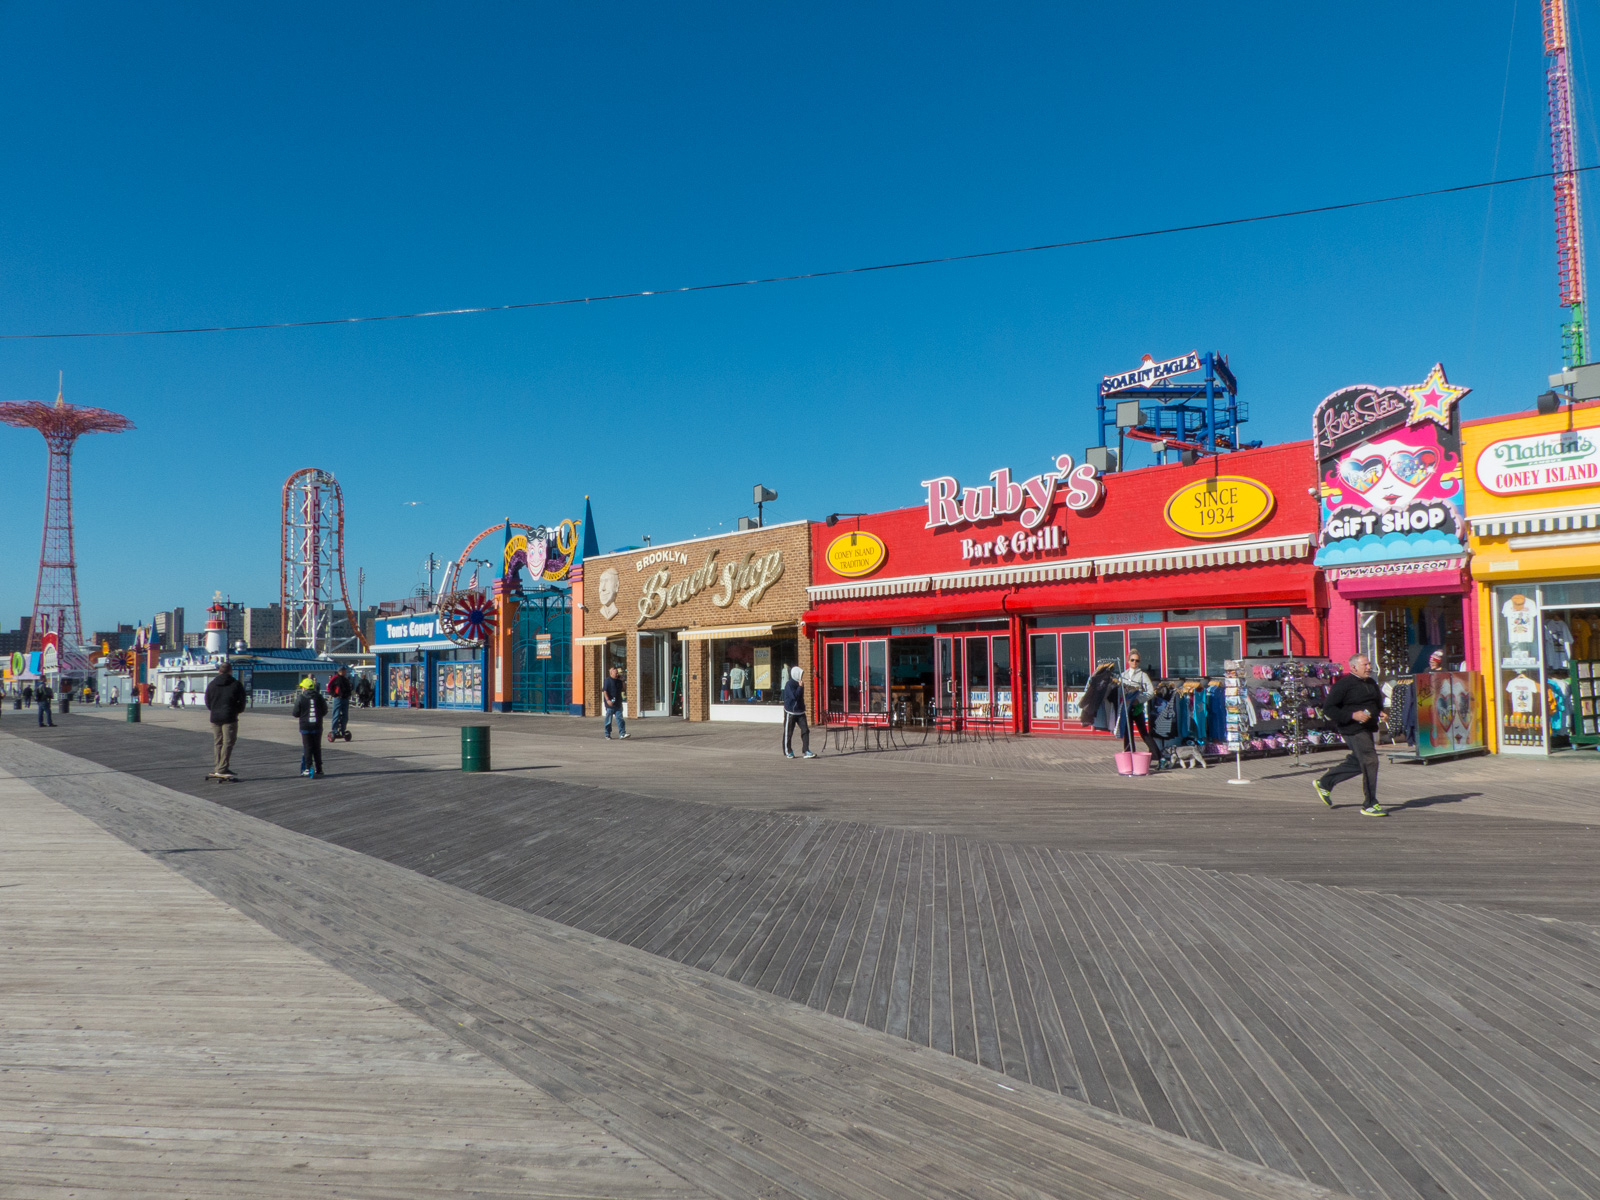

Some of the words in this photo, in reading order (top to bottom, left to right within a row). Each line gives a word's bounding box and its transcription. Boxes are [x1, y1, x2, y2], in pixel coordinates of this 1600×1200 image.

[1102, 368, 1152, 393] SOARIN'
[1153, 355, 1197, 378] EAGLE
[1354, 392, 1406, 422] Star
[1494, 436, 1596, 462] Nathan's
[1495, 470, 1540, 489] CONEY
[1545, 463, 1598, 484] ISLAND
[920, 454, 1099, 529] Ruby's
[1194, 488, 1238, 509] SINCE
[1200, 507, 1235, 526] 1934
[1382, 508, 1446, 533] SHOP
[312, 486, 321, 616] THUNDERBOLT
[1010, 525, 1061, 555] Grill
[636, 551, 688, 572] BROOKLYN
[834, 550, 852, 560] CONEY
[854, 547, 875, 557] ISLAND
[840, 558, 870, 570] TRADITION
[1340, 561, 1447, 577] WWW.LOLASTAR.COM
[636, 548, 719, 627] Beach
[712, 550, 785, 612] Shop
[386, 624, 408, 639] Tom's
[409, 621, 434, 638] Coney
